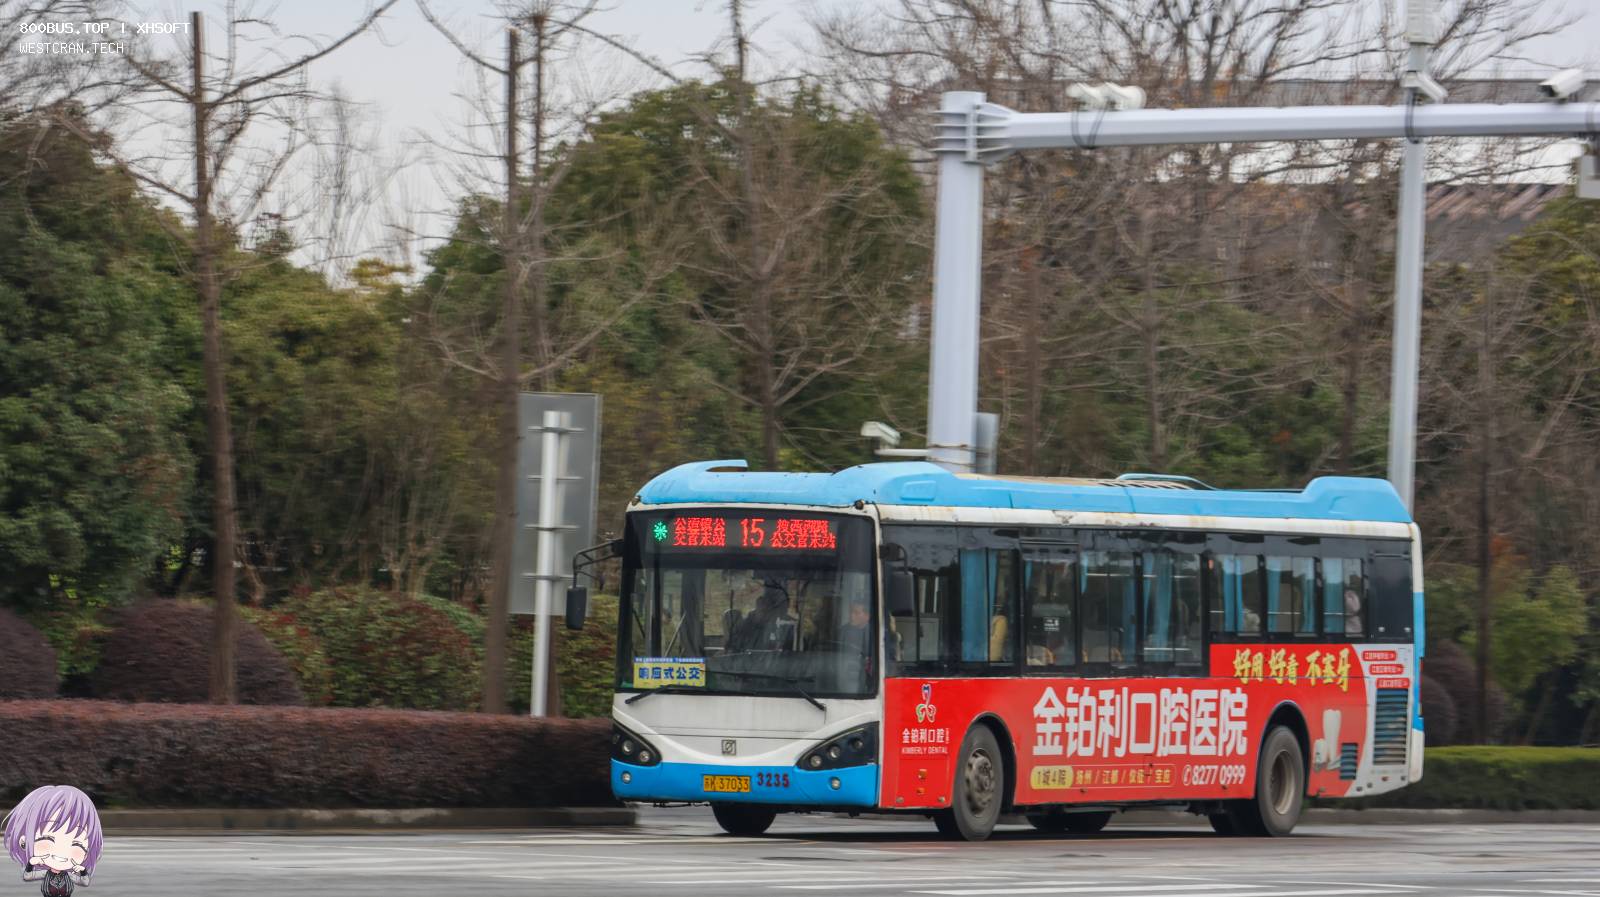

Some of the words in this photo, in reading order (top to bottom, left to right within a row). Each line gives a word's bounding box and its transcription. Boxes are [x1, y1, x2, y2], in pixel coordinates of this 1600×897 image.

[740, 518, 765, 547] 15
[639, 667, 700, 680] 响应式公交
[1233, 648, 1264, 684] 好用
[1032, 687, 1248, 758] 金铂利口腔医院
[902, 728, 945, 744] 金铂利口腔
[757, 772, 790, 788] 3235
[1192, 764, 1218, 786] 8277
[1220, 764, 1246, 785] 0999
